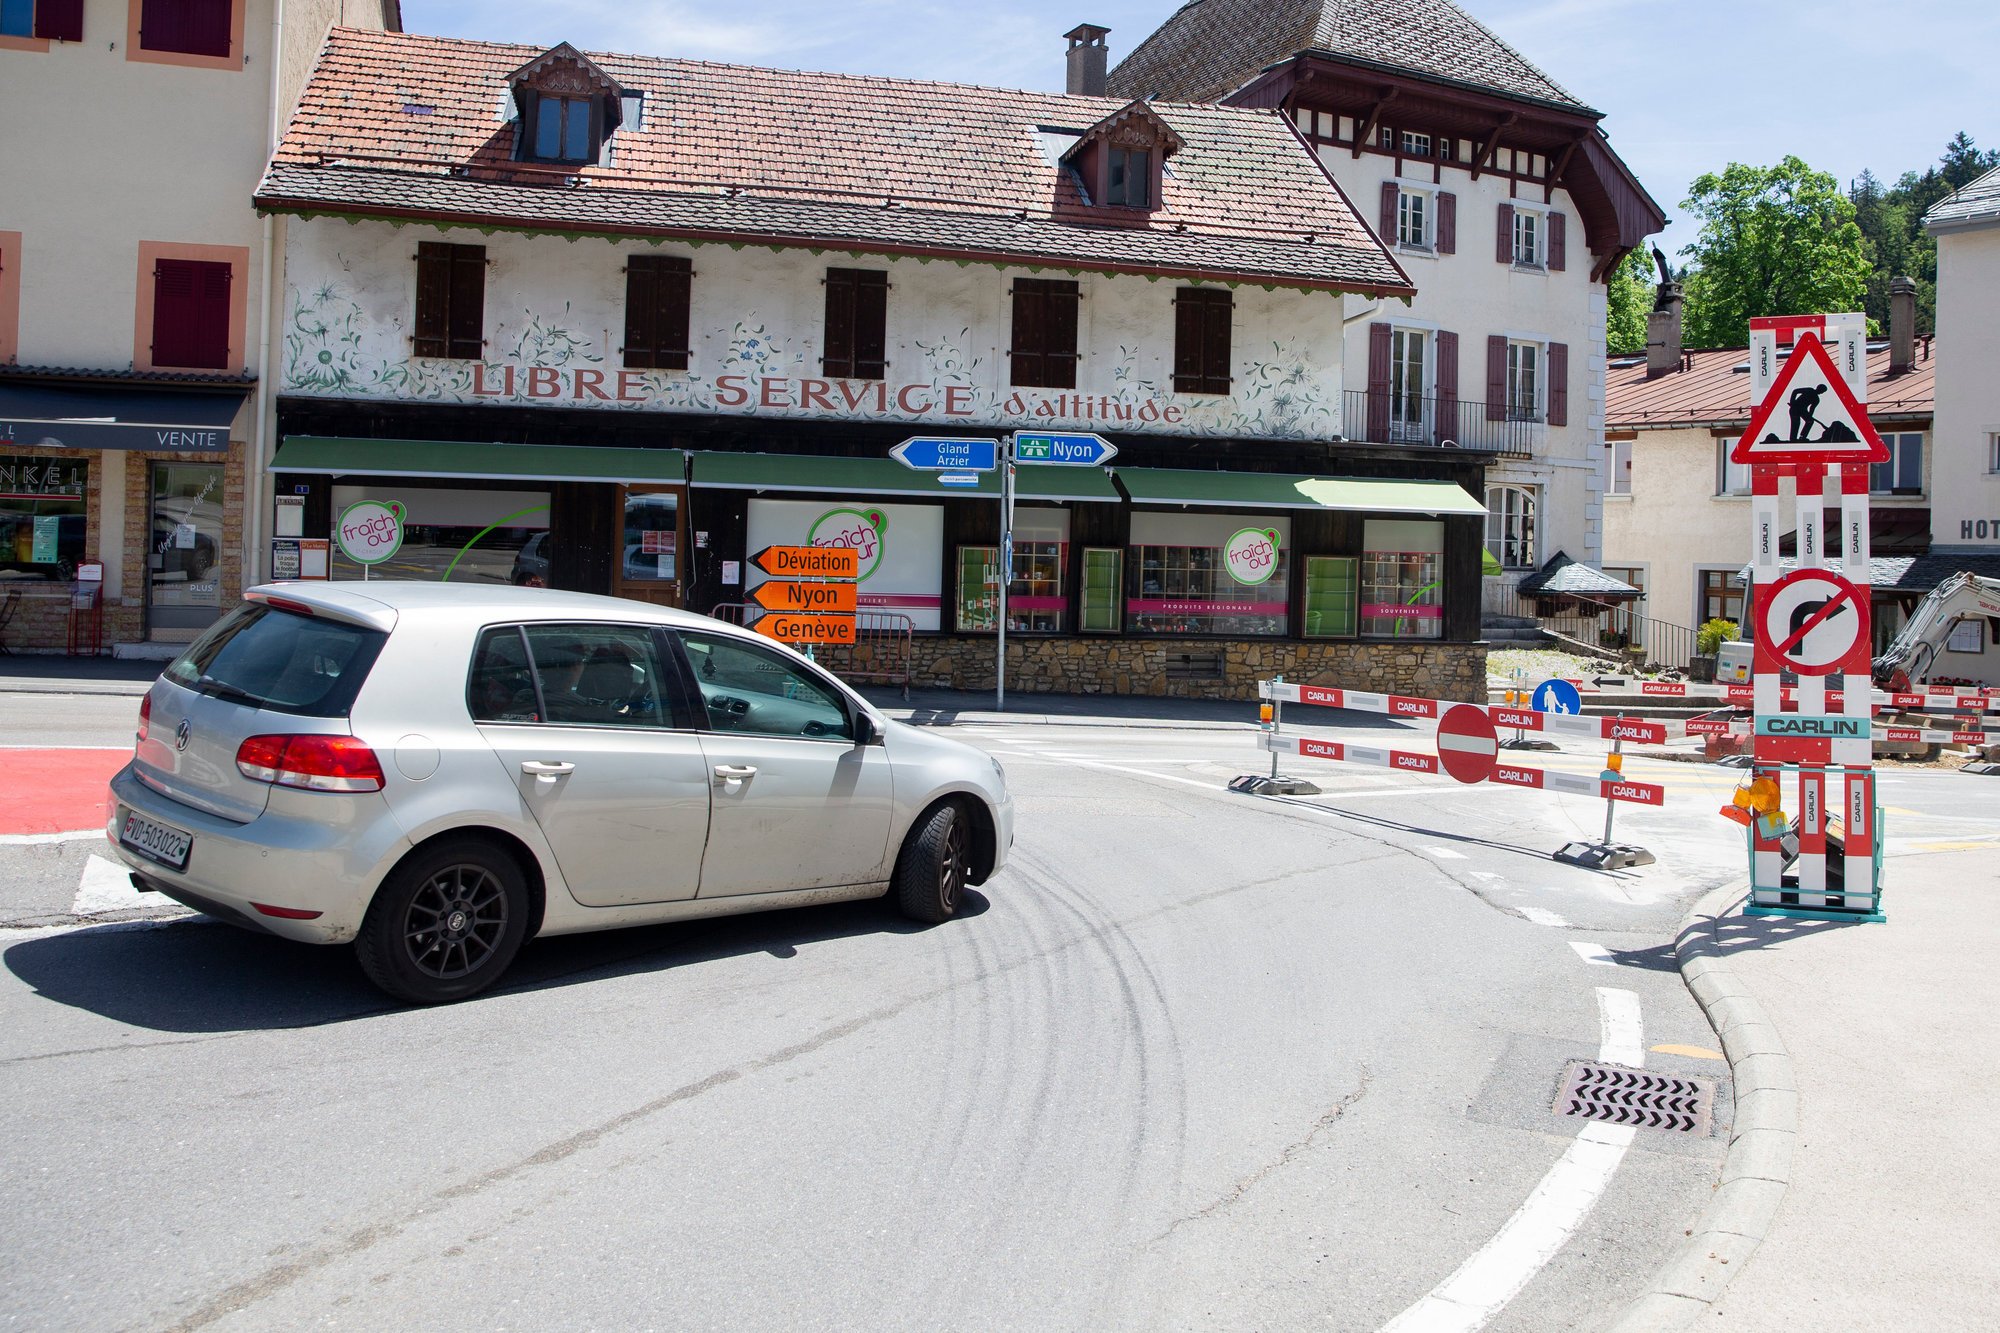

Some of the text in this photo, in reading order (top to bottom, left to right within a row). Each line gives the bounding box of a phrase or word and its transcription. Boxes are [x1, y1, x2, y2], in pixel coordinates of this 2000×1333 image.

[472, 363, 1184, 423] LIBRE SERVICE d'altitude
[157, 431, 217, 446] VENTE
[937, 443, 970, 455] Gland
[1053, 440, 1093, 461] Nyon
[937, 456, 970, 468] Arzier
[367, 528, 397, 547] our
[857, 541, 877, 560] ur
[777, 551, 850, 571] Déviation
[1249, 552, 1273, 569] our
[190, 584, 213, 592] PLUS
[788, 585, 838, 608] Nyon
[774, 618, 849, 638] Genève
[1307, 691, 1335, 703] CARLIN
[1963, 699, 1984, 707] CARLIN
[1397, 702, 1428, 714] CARLIN
[1498, 713, 1533, 725] CARLIN
[1614, 725, 1652, 739] CARLIN
[1767, 718, 1858, 735] CARLIN
[1306, 744, 1335, 756] CARLIN
[1398, 756, 1429, 768] CARLIN
[1498, 769, 1533, 783] CARLIN
[1612, 785, 1651, 800] CARLIN
